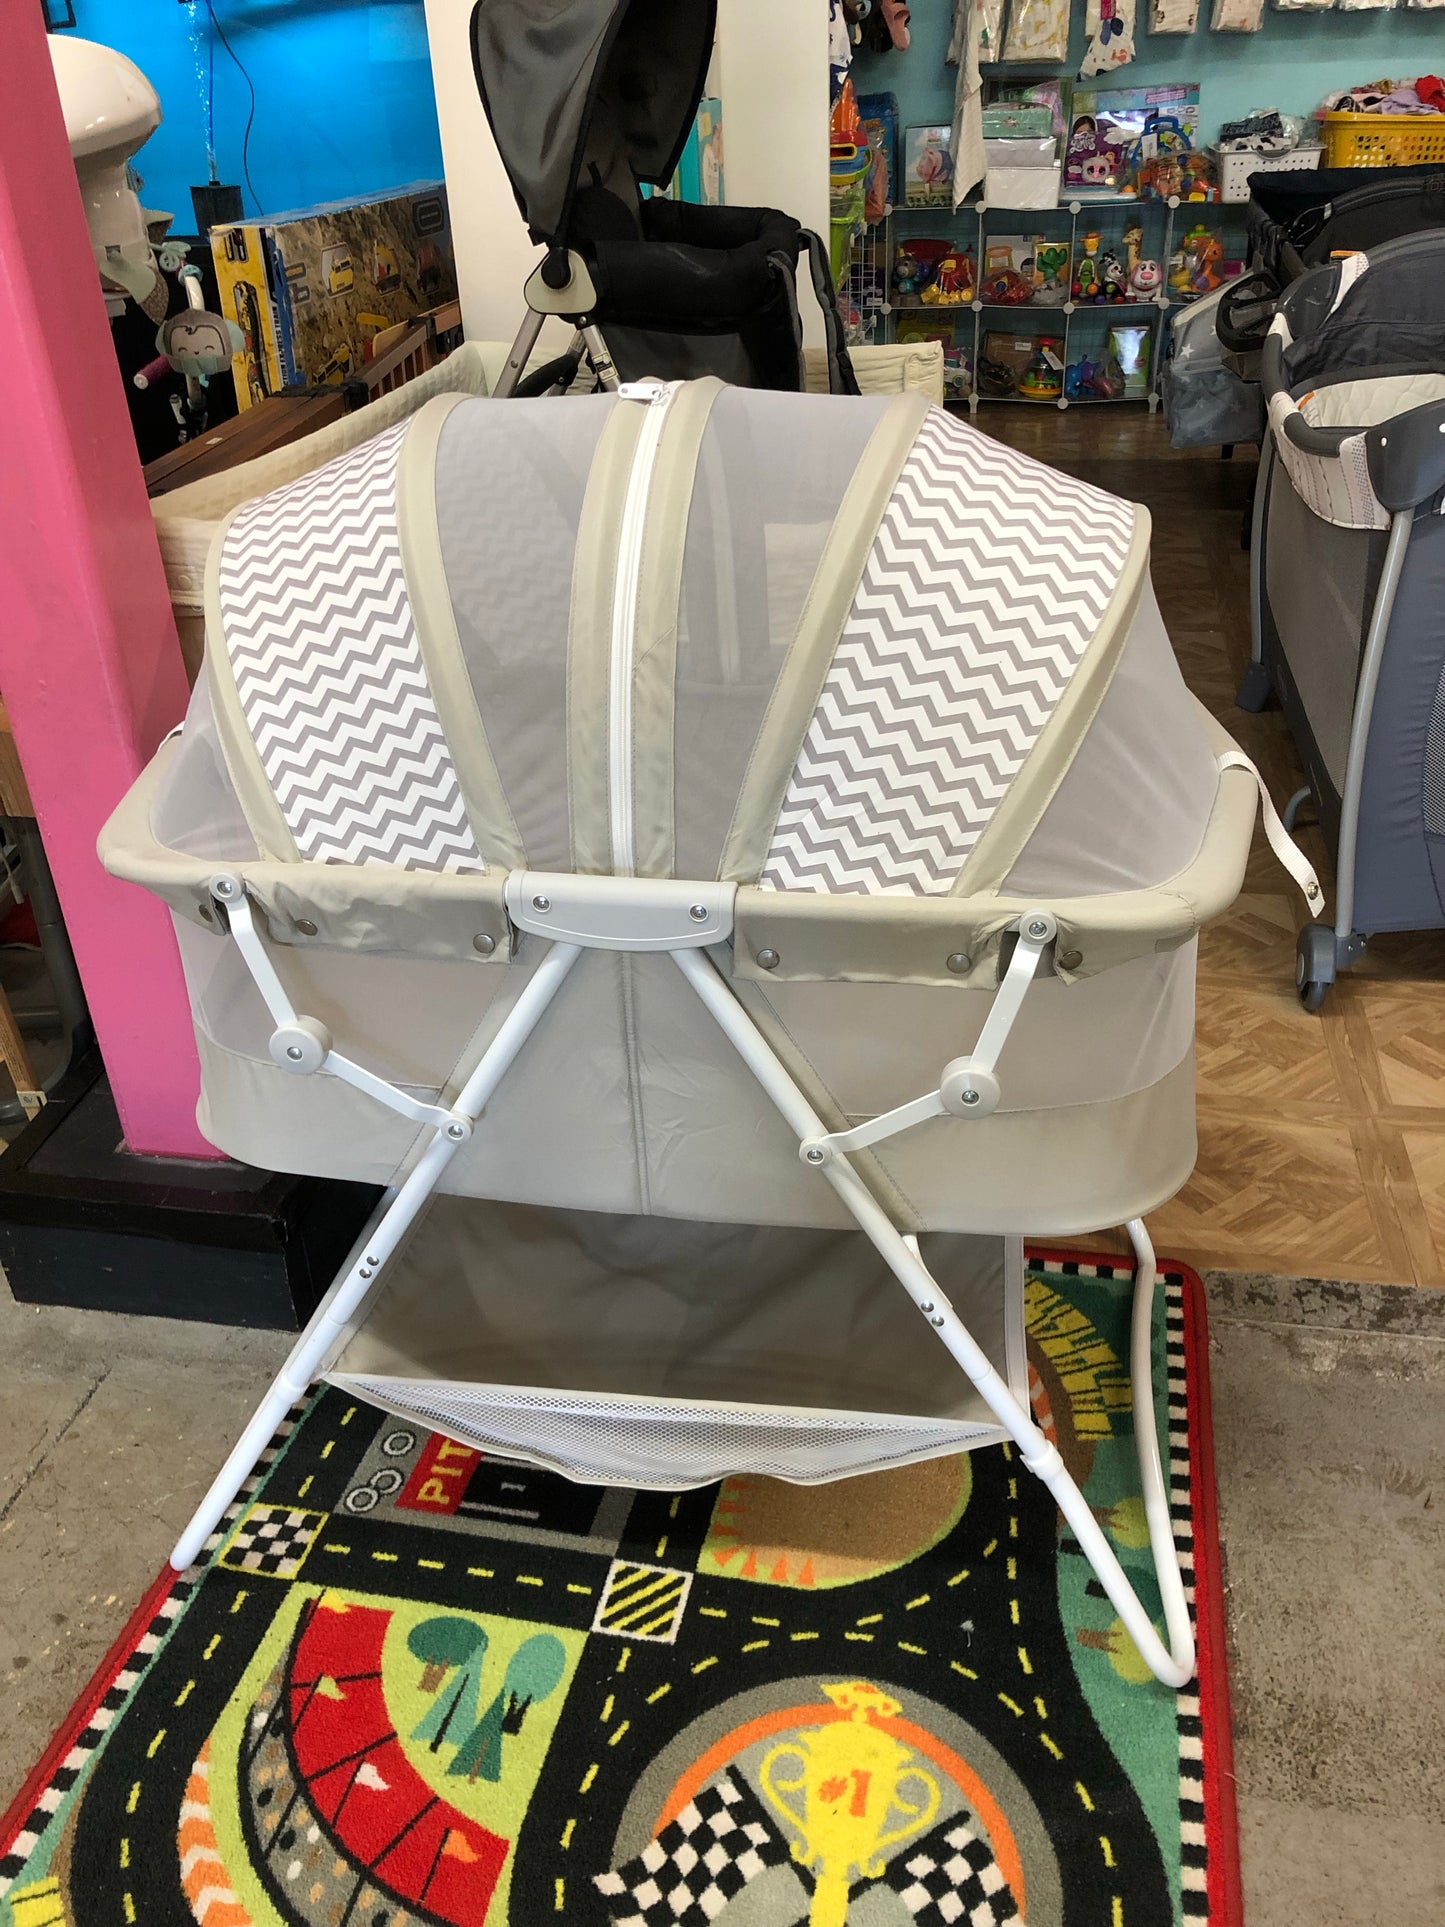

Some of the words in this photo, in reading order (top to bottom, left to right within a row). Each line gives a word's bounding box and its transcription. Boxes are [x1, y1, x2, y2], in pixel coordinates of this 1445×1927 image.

[276, 330, 285, 362] EXPRESS
[416, 1439, 473, 1504] PIT
[818, 1769, 872, 1818] #1
